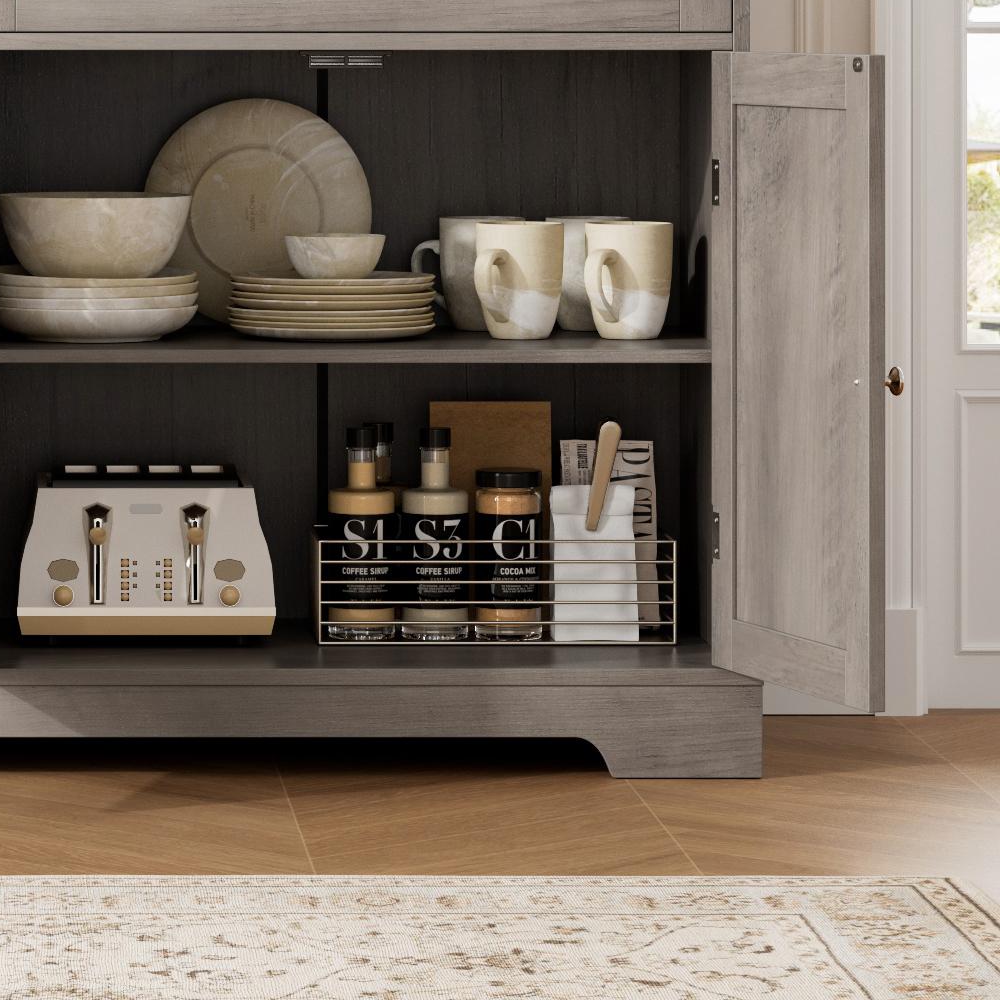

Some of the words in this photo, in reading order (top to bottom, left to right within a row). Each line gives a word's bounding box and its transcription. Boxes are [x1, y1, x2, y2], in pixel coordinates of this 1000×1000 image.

[342, 518, 388, 560] S1
[413, 518, 463, 560] S3
[492, 518, 539, 560] C1
[342, 567, 369, 576] COFFEE
[370, 566, 389, 575] SIRUP
[415, 567, 442, 576] COFFEE
[443, 567, 463, 575] SIRUP
[500, 567, 524, 576] COCOA
[525, 566, 537, 575] MIX
